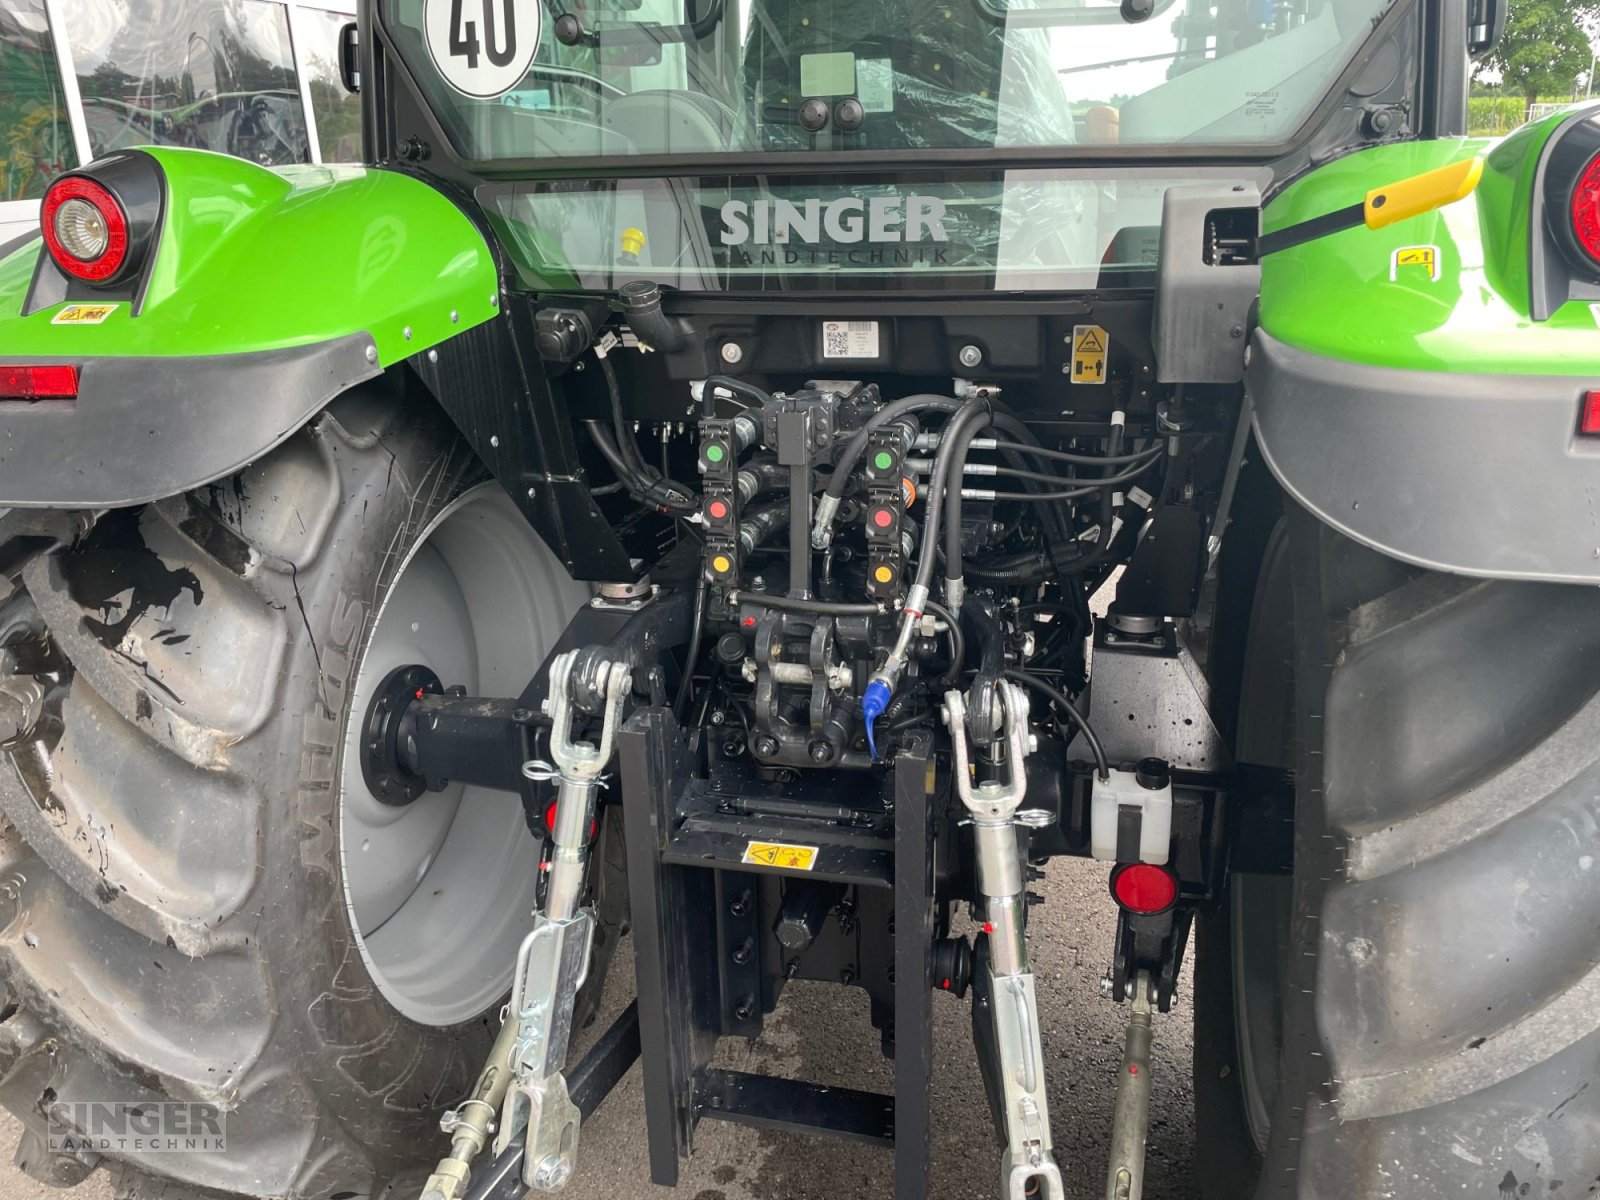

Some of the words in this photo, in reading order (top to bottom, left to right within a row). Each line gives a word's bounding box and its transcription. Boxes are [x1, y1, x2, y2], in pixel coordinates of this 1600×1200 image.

[449, 0, 517, 69] 40
[720, 196, 949, 245] SINGER
[727, 249, 948, 265] ANDTECHNIK
